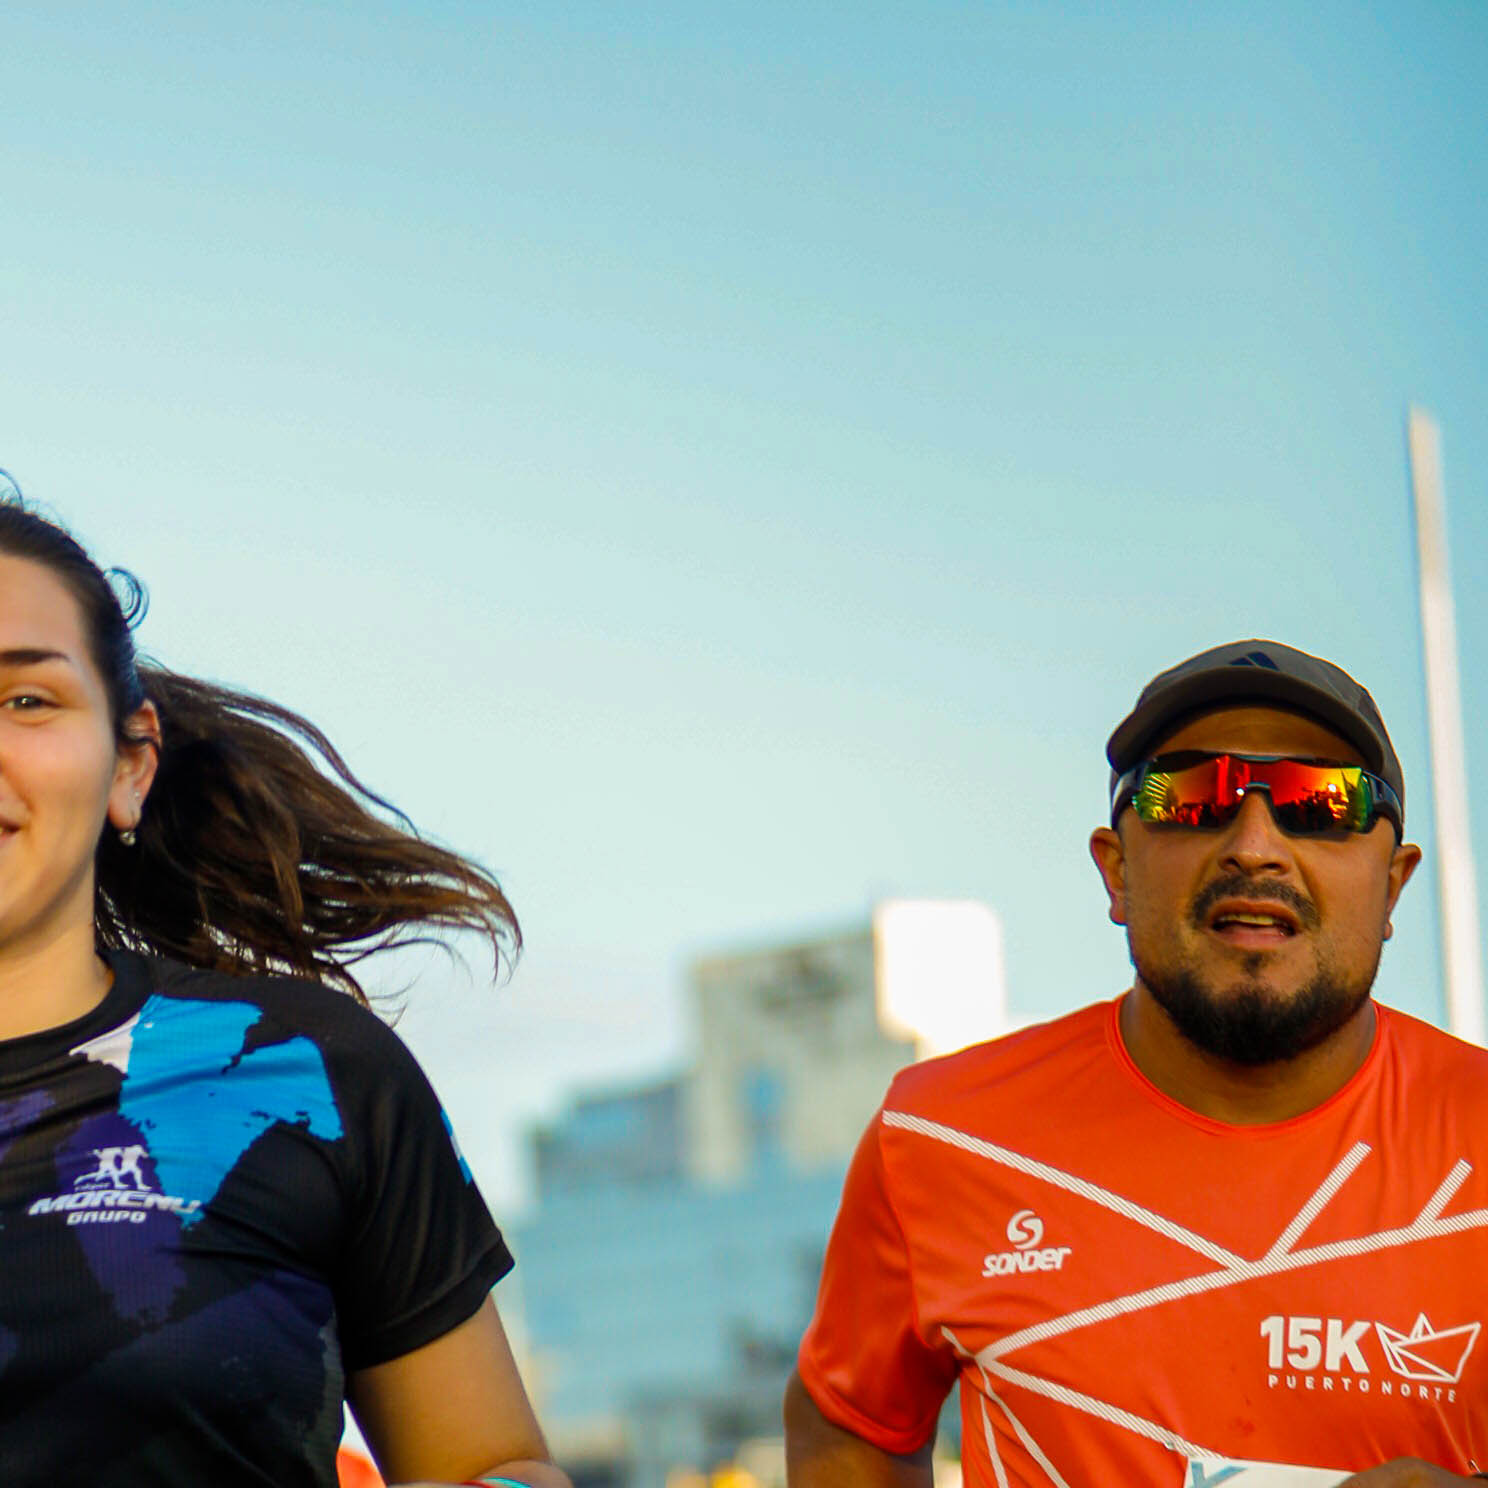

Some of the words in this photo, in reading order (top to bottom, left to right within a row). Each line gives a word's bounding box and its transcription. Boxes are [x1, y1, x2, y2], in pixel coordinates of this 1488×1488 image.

[1260, 1315, 1372, 1374] 15K
[1268, 1373, 1370, 1394] PUERTO
[1381, 1380, 1456, 1403] NORTE
